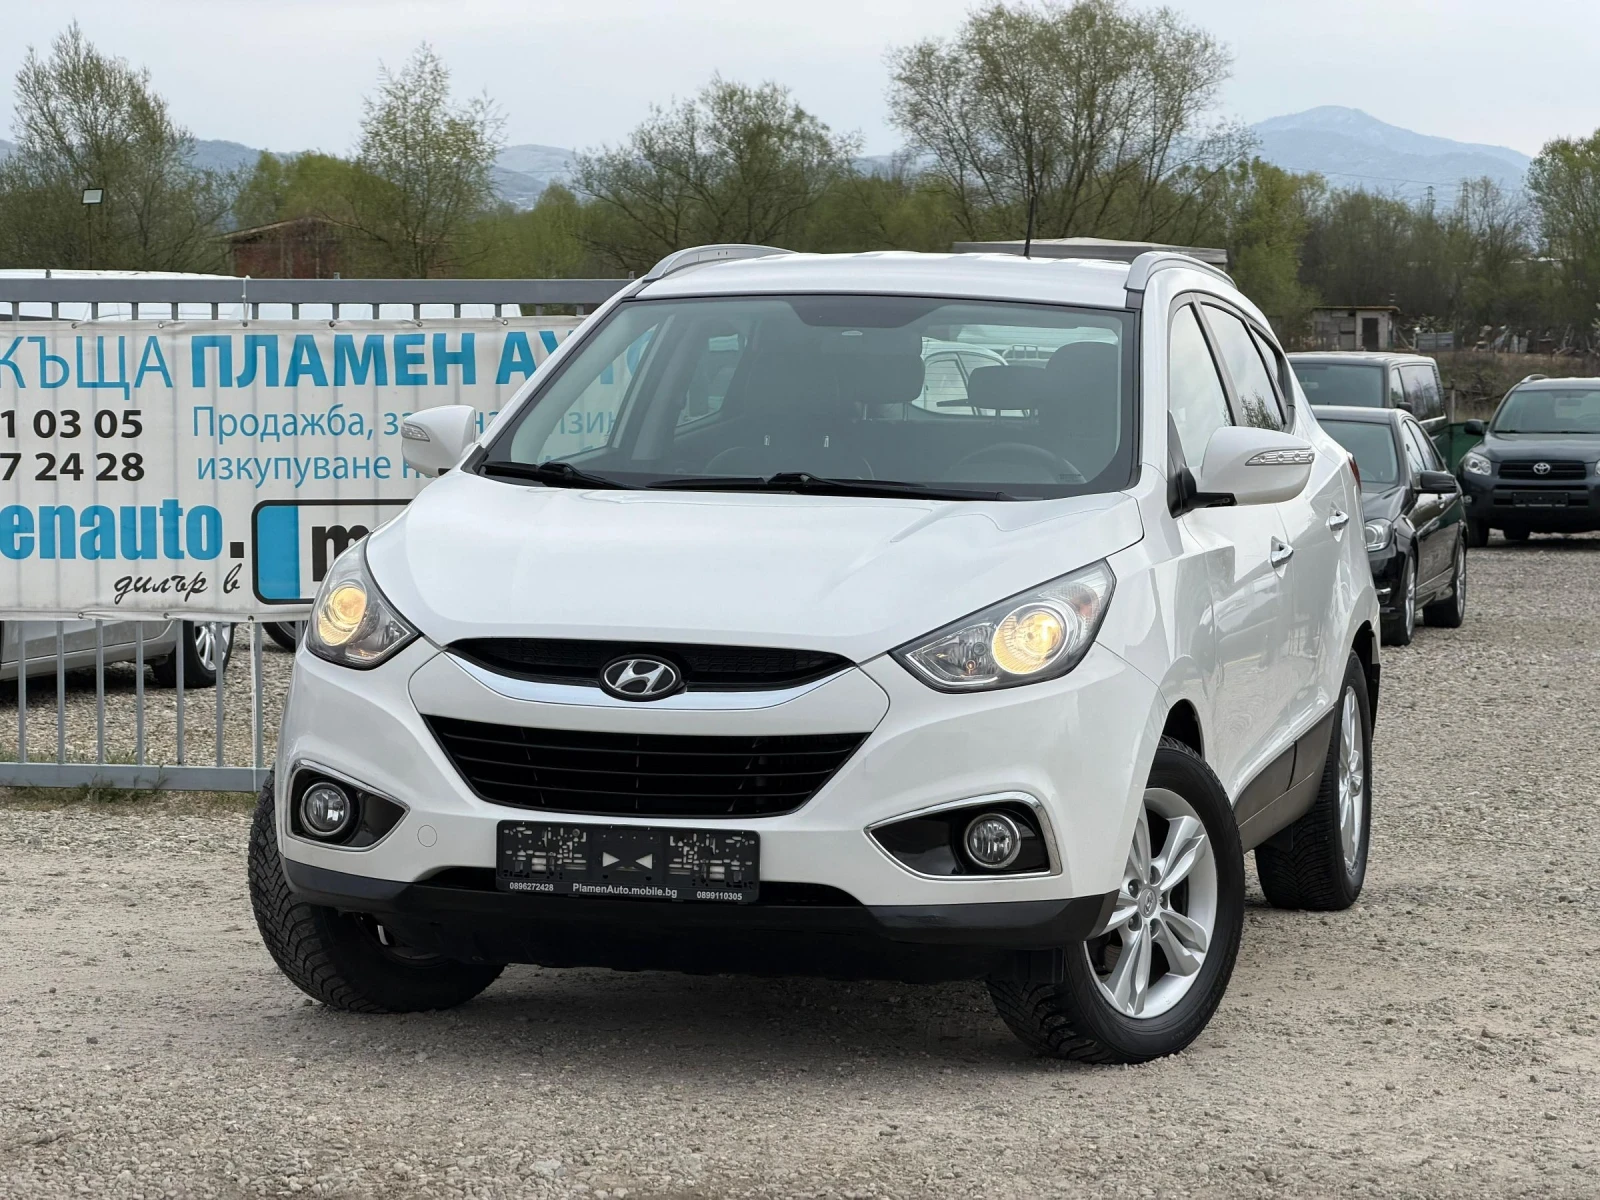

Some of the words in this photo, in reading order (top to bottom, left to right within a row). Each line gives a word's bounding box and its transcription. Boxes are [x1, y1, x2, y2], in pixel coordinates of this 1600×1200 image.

[0, 335, 173, 400] КЪЩА
[191, 332, 476, 388] ПЛАМЕН
[33, 409, 82, 438] 03
[94, 409, 143, 438] 05
[193, 404, 373, 444] Продажба,
[0, 453, 22, 481] 7
[34, 453, 84, 481] 24
[96, 452, 145, 481] 28
[197, 455, 391, 489] изкупуване
[114, 571, 208, 605] дилър
[223, 563, 243, 594] в
[509, 882, 554, 892] 0896272428
[572, 883, 678, 899] PlamenAuto.mobile.bg
[696, 890, 743, 901] 0899110305
